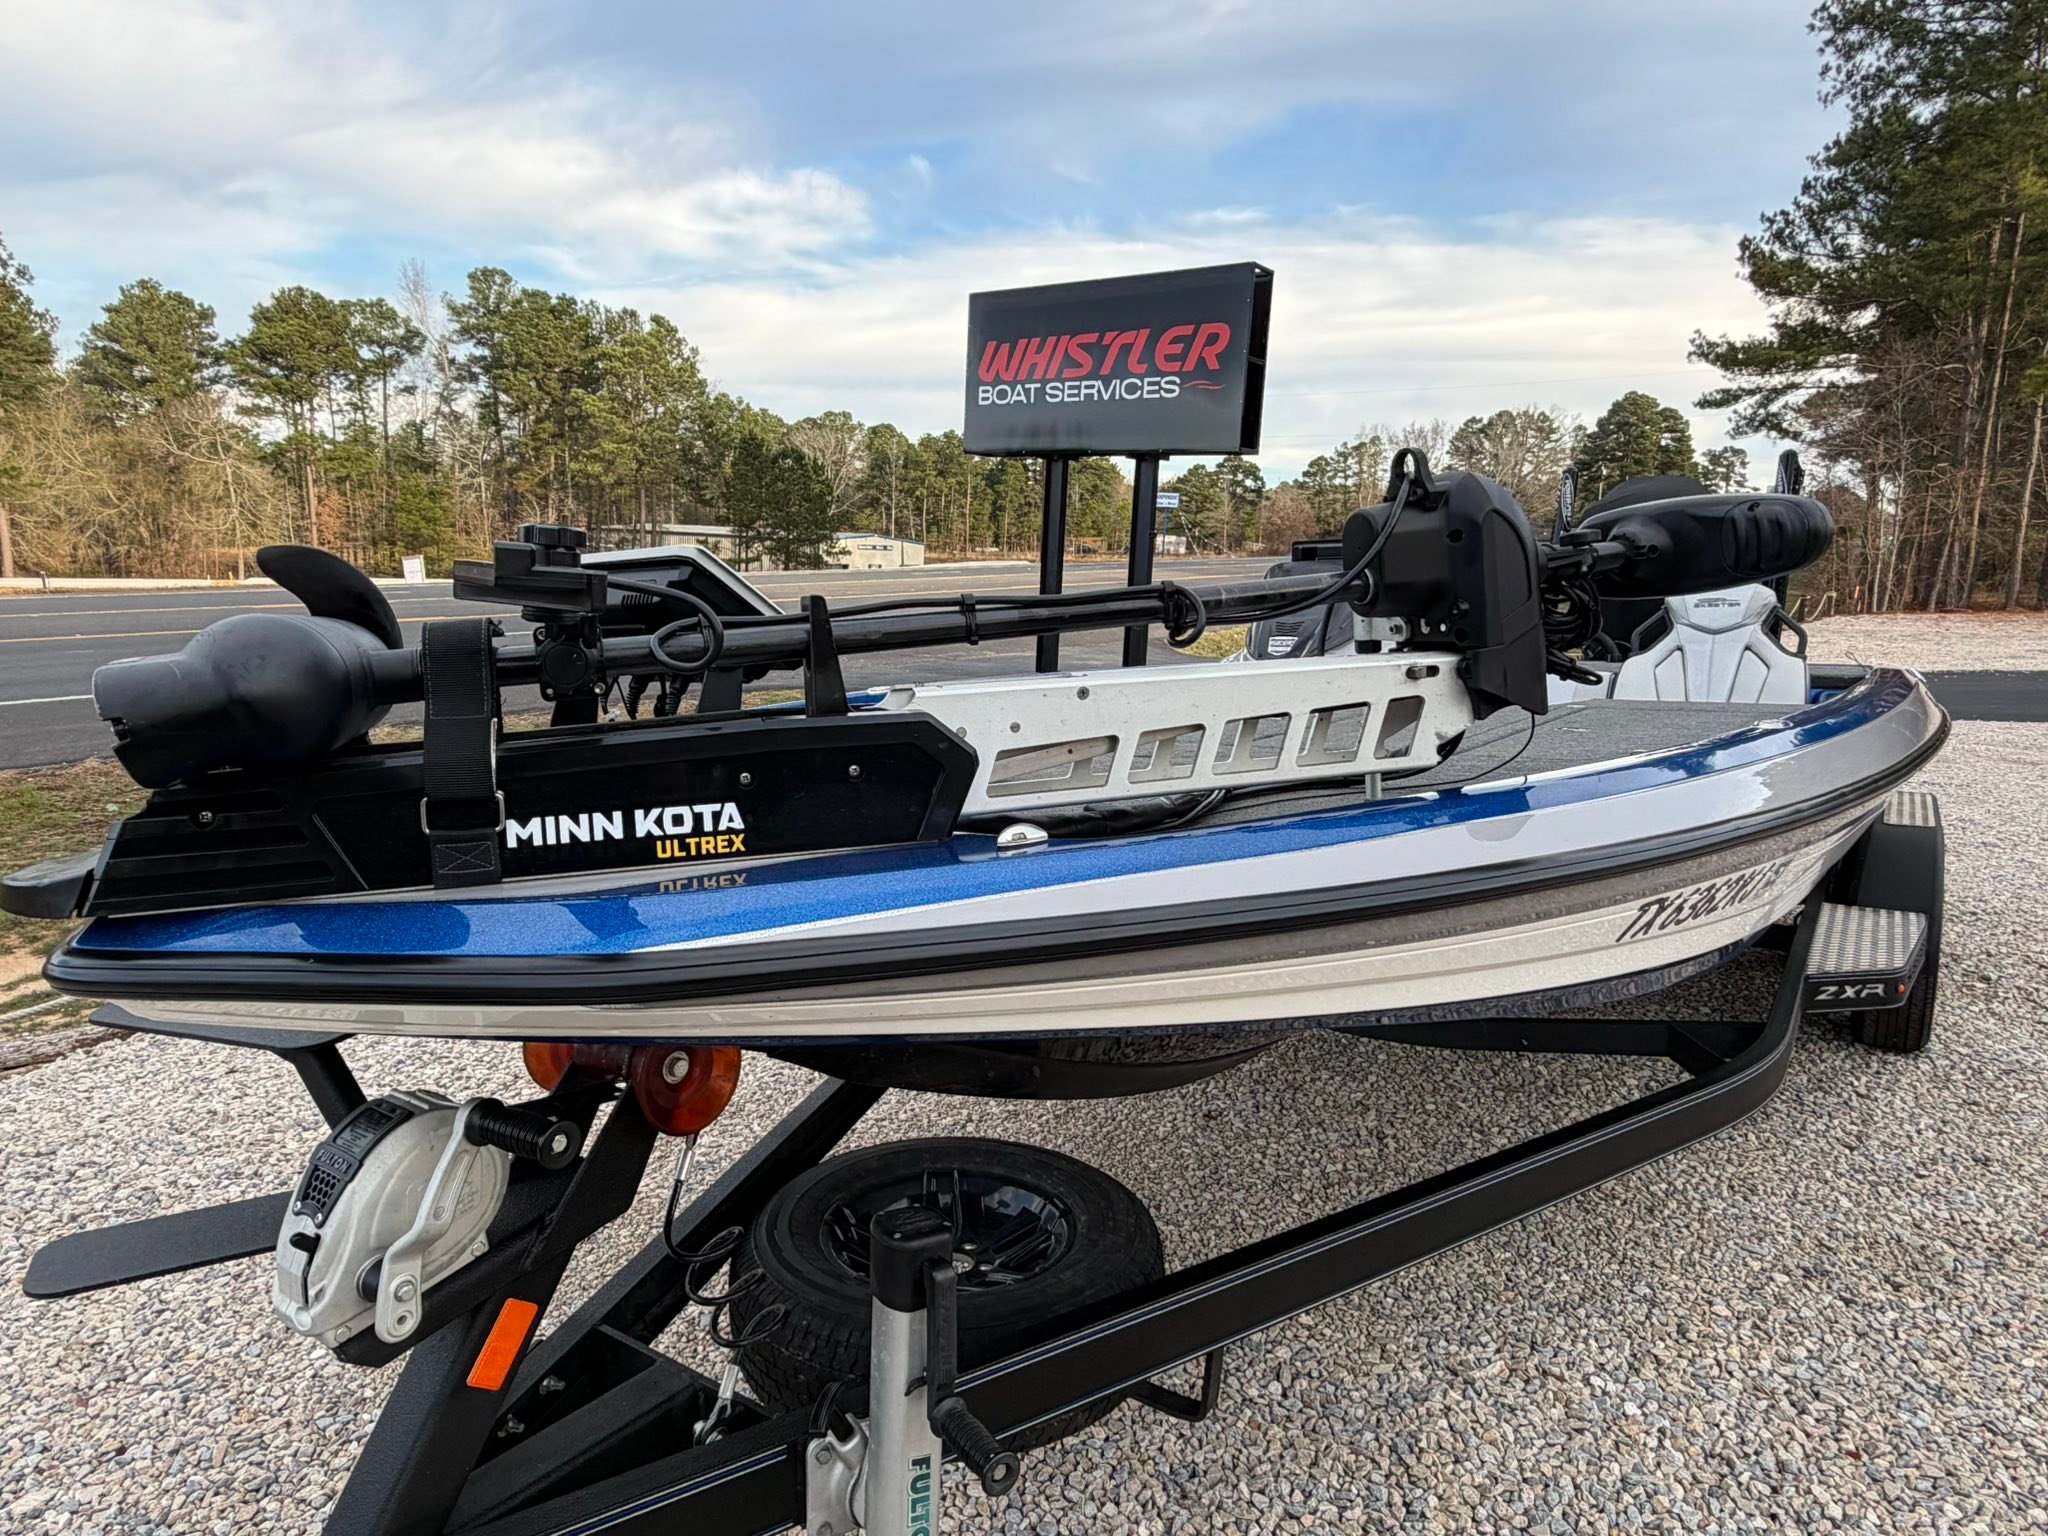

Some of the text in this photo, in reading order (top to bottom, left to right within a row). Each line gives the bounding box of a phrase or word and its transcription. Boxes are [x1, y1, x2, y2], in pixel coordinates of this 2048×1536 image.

[978, 322, 1231, 382] WHISTLER
[978, 376, 1180, 405] BOAT SERVICES
[505, 802, 745, 848] MINN KOTA
[656, 833, 746, 859] ULTREX
[1814, 983, 1886, 1001] ZXR
[315, 1150, 350, 1174] FULTON
